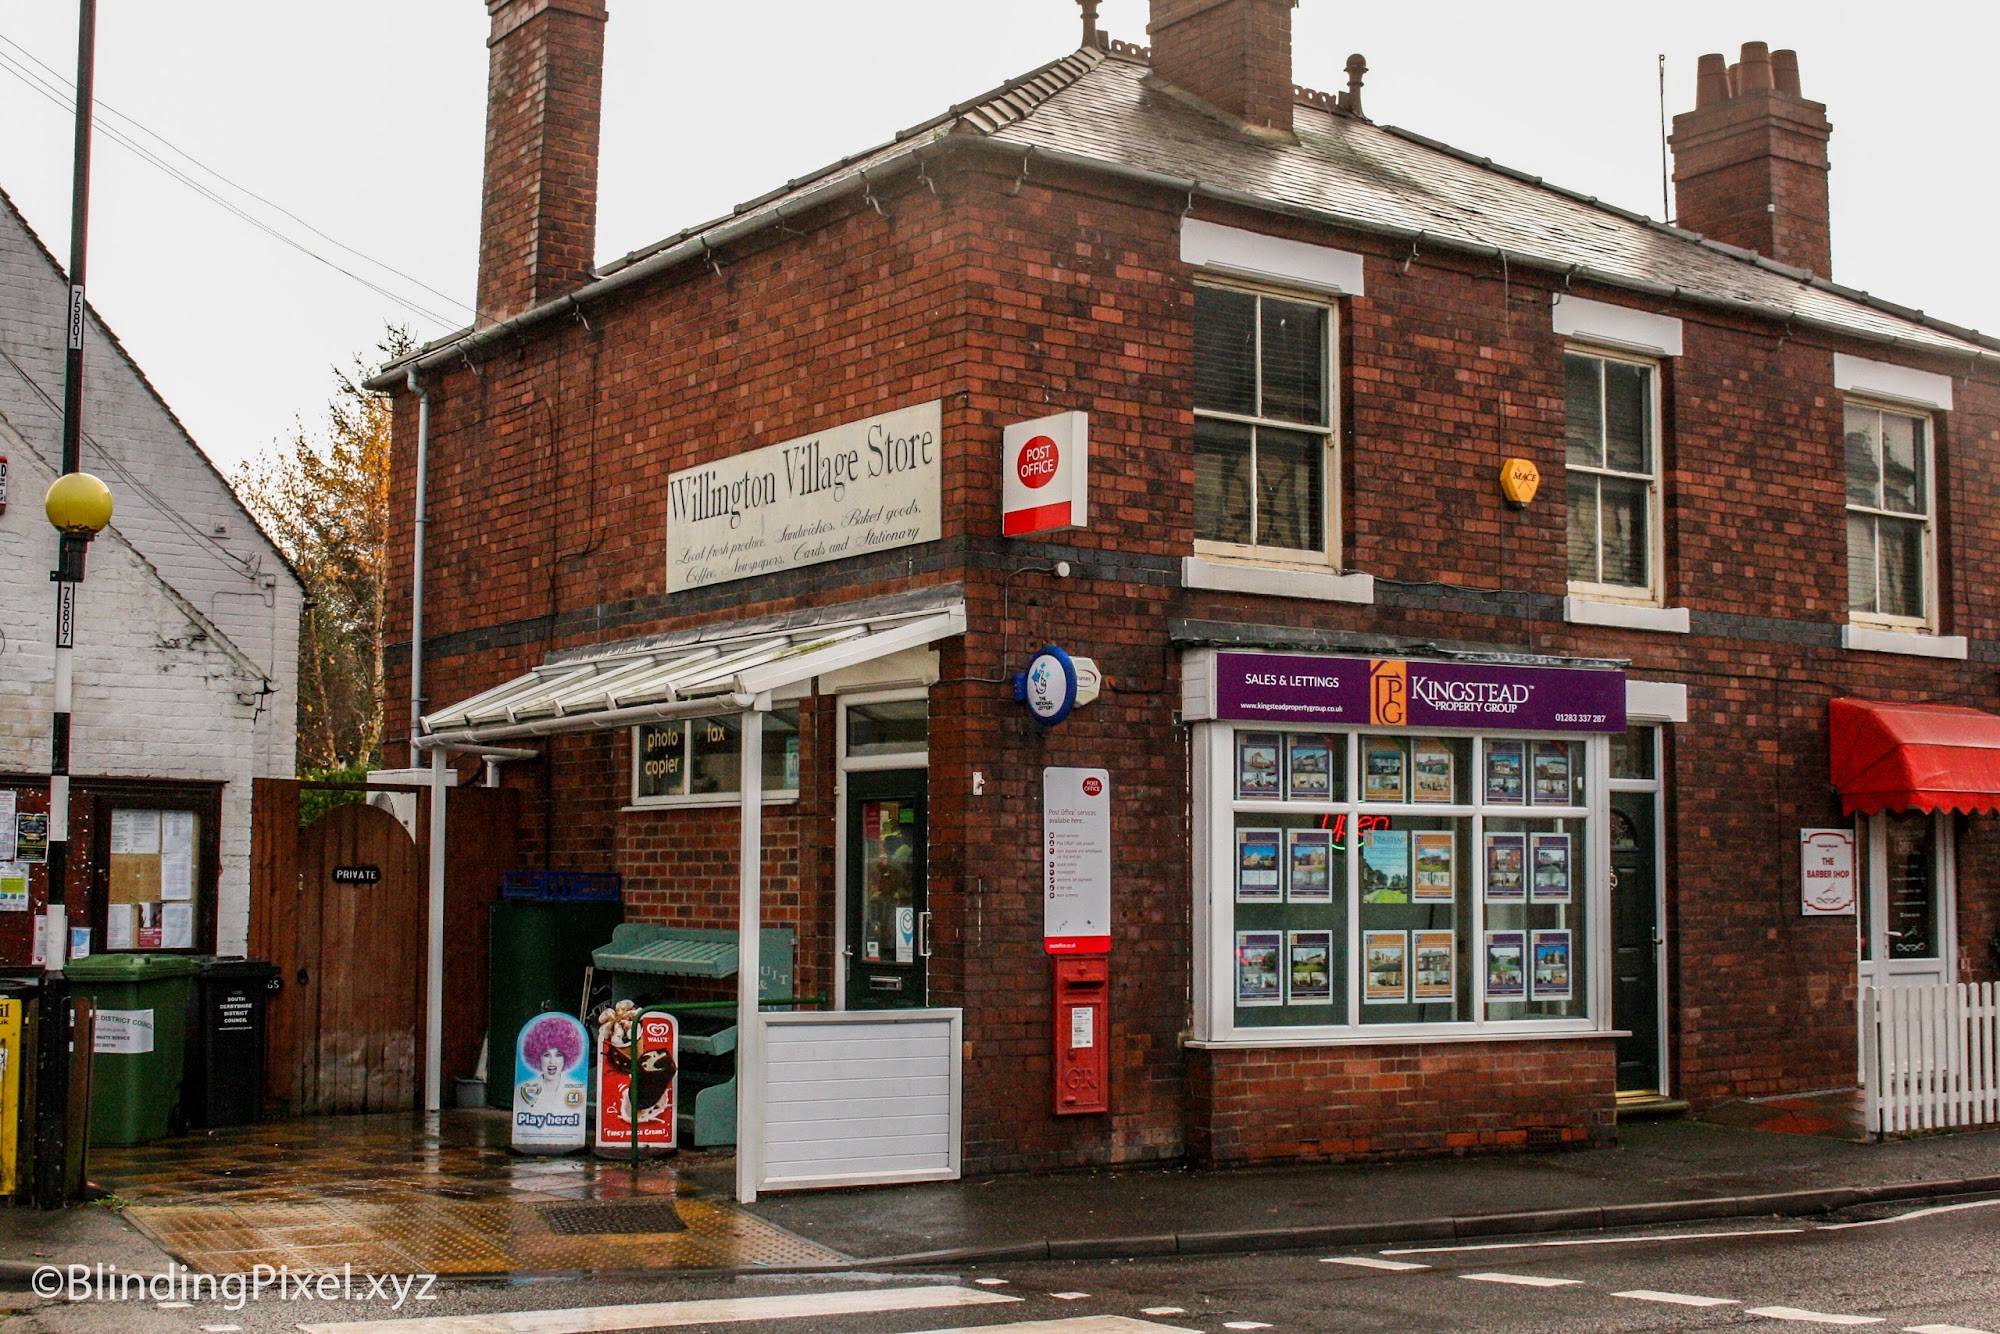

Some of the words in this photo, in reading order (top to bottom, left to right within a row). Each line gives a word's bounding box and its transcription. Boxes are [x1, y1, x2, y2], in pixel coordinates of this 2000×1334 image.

[72, 290, 82, 347] 75801
[1026, 445, 1051, 462] POST
[1020, 459, 1054, 478] OFFICE
[669, 471, 776, 529] Willington
[782, 440, 859, 502] Village
[867, 424, 934, 480] Store
[1513, 472, 1537, 482] MACE
[675, 545, 706, 566] Local
[706, 541, 729, 562] fresh
[841, 505, 884, 528] Baked
[792, 541, 826, 561] Cards
[828, 536, 850, 554] and
[856, 527, 920, 547] Stationary
[62, 586, 71, 644] 75807
[1245, 673, 1277, 686] SALES
[1279, 674, 1287, 687] &
[1289, 675, 1340, 688] LETTINGS
[1240, 702, 1344, 713] www.kingsteadpropertygroup.co.uk
[1435, 700, 1483, 713] PROPERTY
[1484, 702, 1518, 714] GROUP
[1555, 713, 1578, 723] 01283
[1578, 714, 1592, 723] 337
[1592, 714, 1606, 723] 287
[647, 727, 679, 752] photo
[707, 722, 725, 743] fax
[645, 754, 679, 779] copier
[1049, 808, 1060, 816] Post
[1822, 857, 1834, 866] THE
[336, 869, 377, 879] PRIVATE
[1806, 870, 1831, 878] BARBER
[1833, 870, 1850, 878] SHOP
[101, 1015, 131, 1025] DISTRICT
[1065, 1067, 1097, 1090] GR
[517, 1112, 546, 1128] Play
[546, 1112, 580, 1126] here!
[607, 1130, 625, 1138] Fancy
